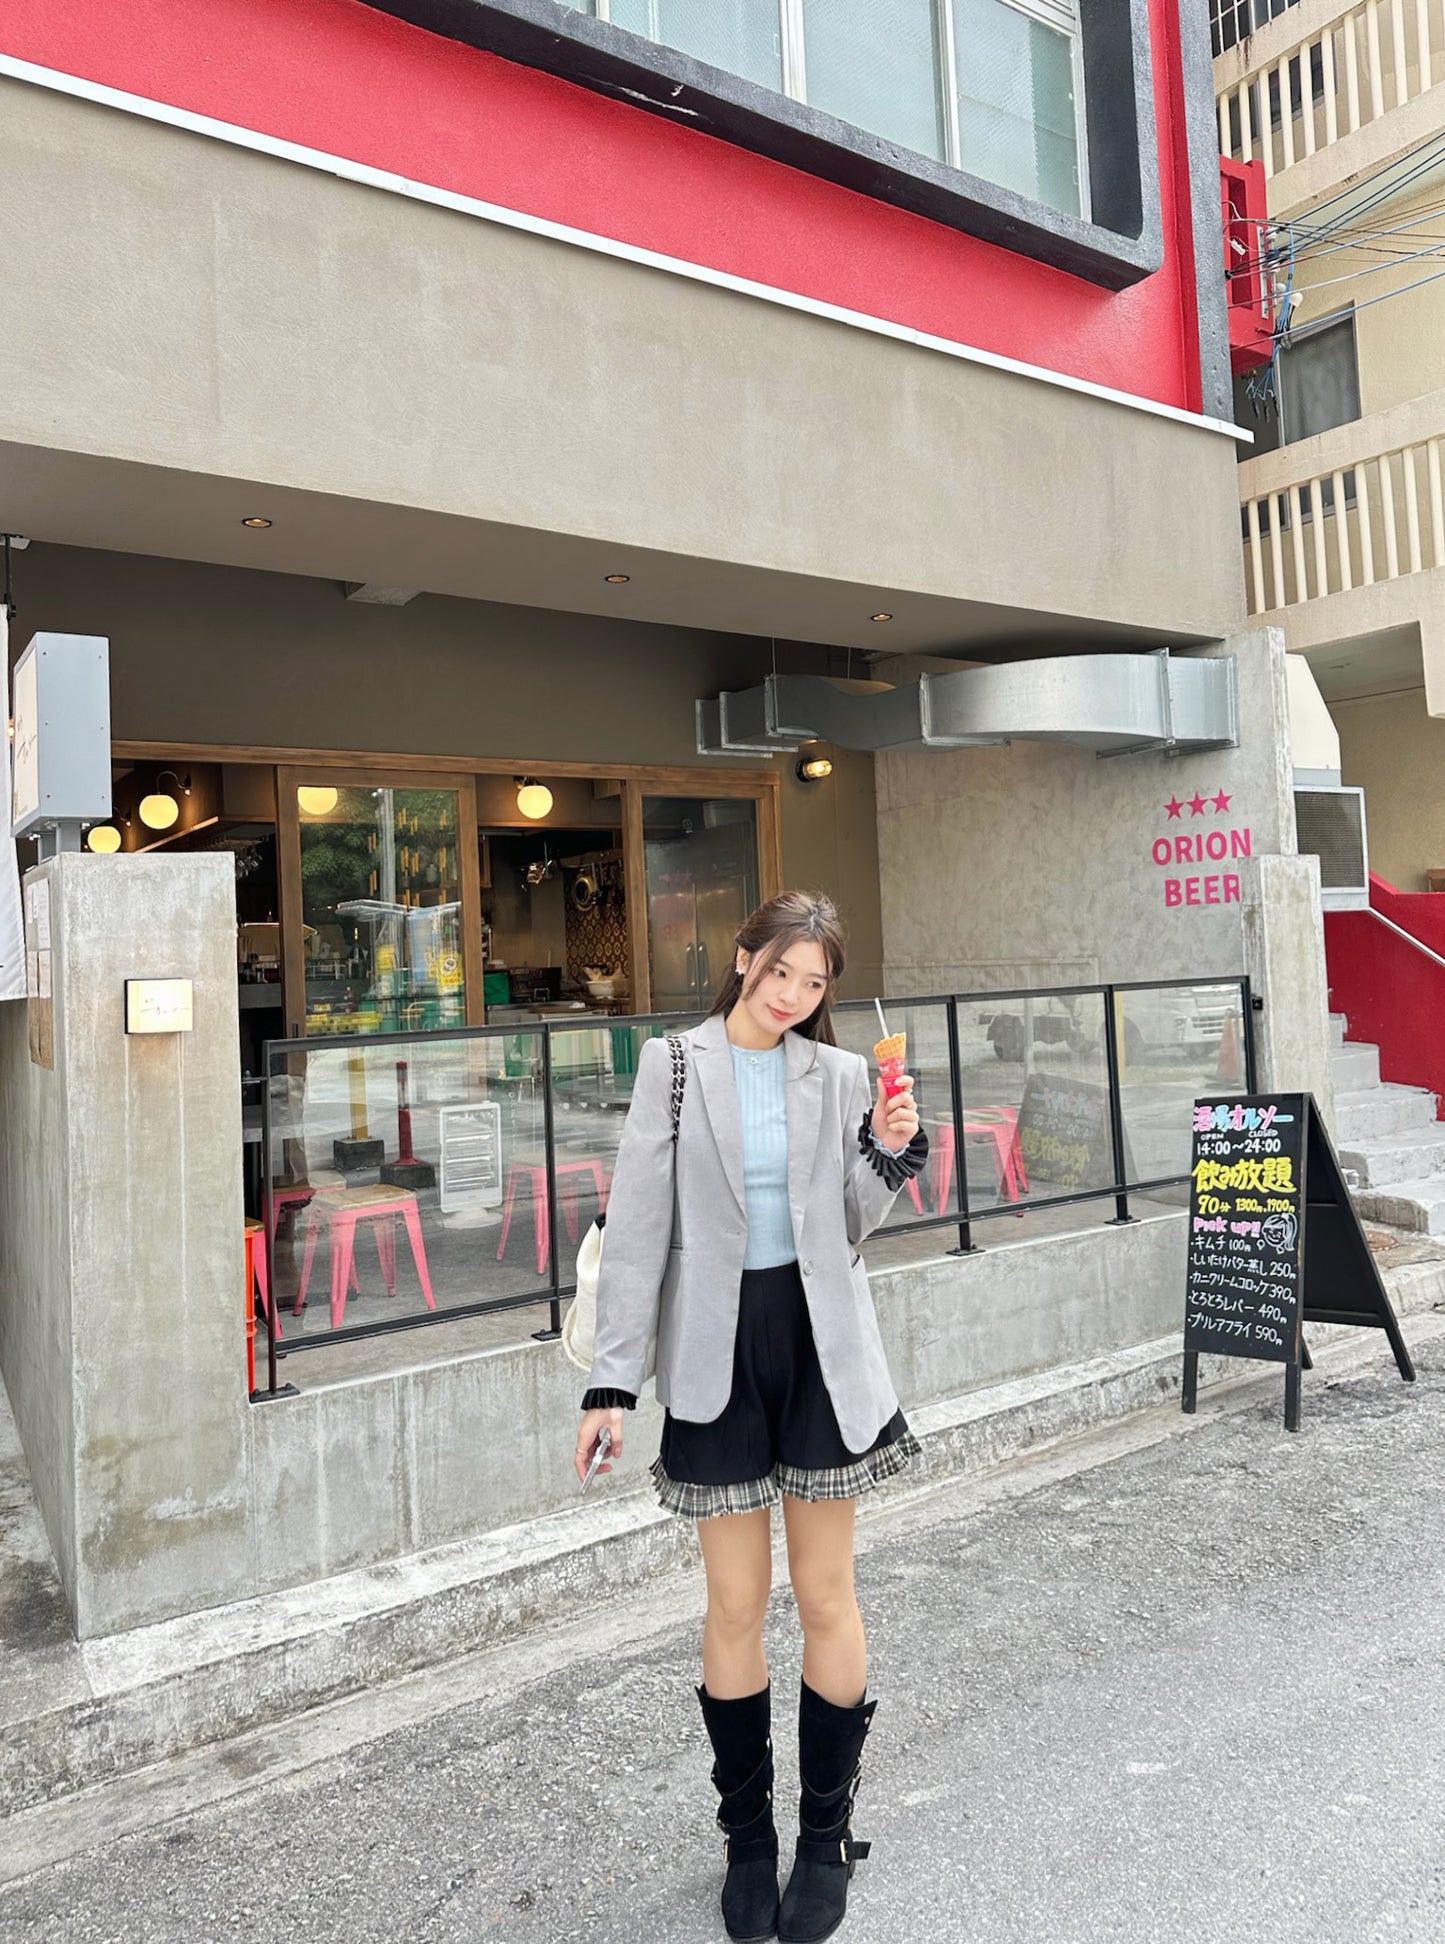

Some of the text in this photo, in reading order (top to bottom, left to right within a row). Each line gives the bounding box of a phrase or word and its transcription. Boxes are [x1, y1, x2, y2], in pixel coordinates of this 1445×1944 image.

[1152, 828, 1251, 866] ORION
[1165, 874, 1240, 907] BEER
[1201, 1128, 1278, 1141] OPEN CLOSED
[1191, 1157, 1297, 1193] 飲み放題
